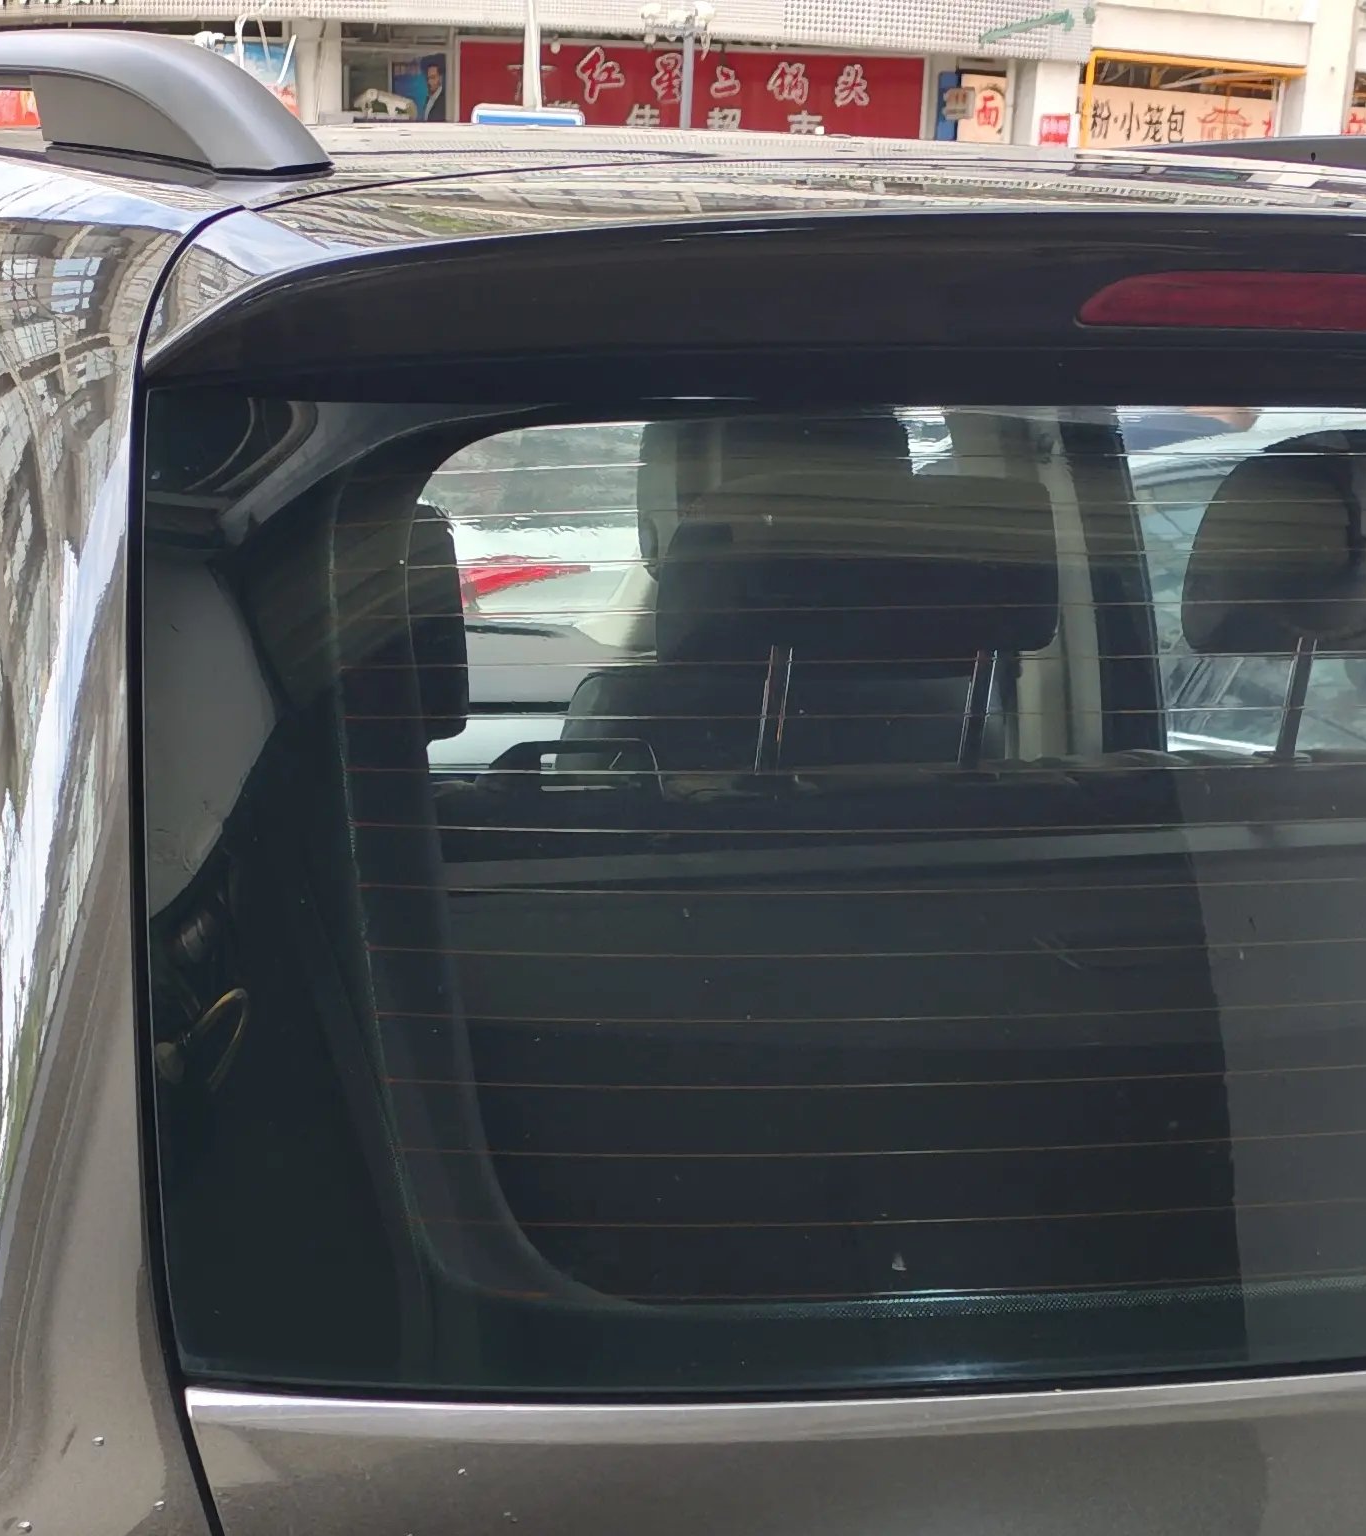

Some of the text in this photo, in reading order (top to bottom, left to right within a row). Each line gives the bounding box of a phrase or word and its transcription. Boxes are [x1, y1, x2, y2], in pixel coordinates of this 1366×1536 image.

[577, 46, 871, 107] 红星二锅头
[547, 101, 823, 134] 佳超市
